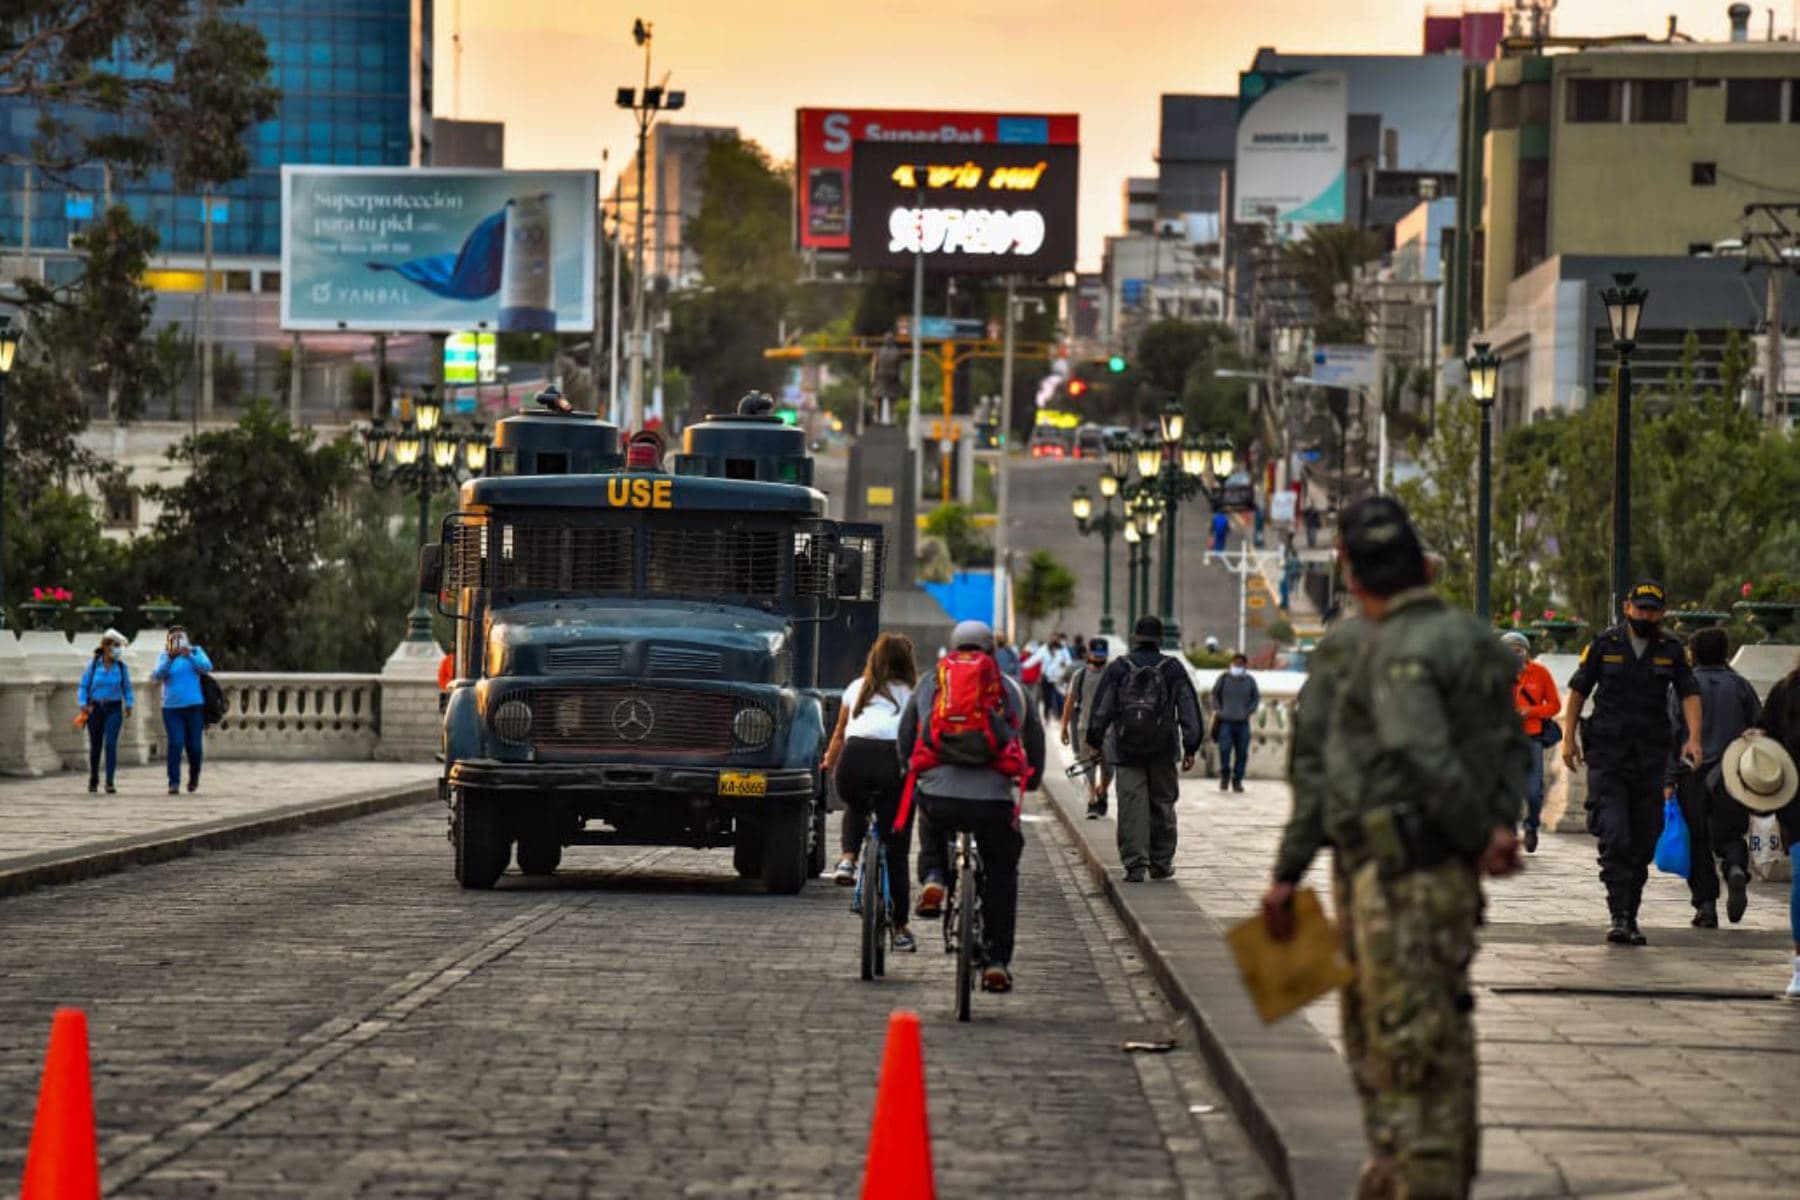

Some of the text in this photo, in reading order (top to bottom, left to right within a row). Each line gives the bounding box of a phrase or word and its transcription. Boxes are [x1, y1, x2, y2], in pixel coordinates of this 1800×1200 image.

[314, 217, 354, 236] para
[379, 213, 413, 238] piel
[337, 287, 410, 304] YANBAL
[608, 478, 672, 508] USE
